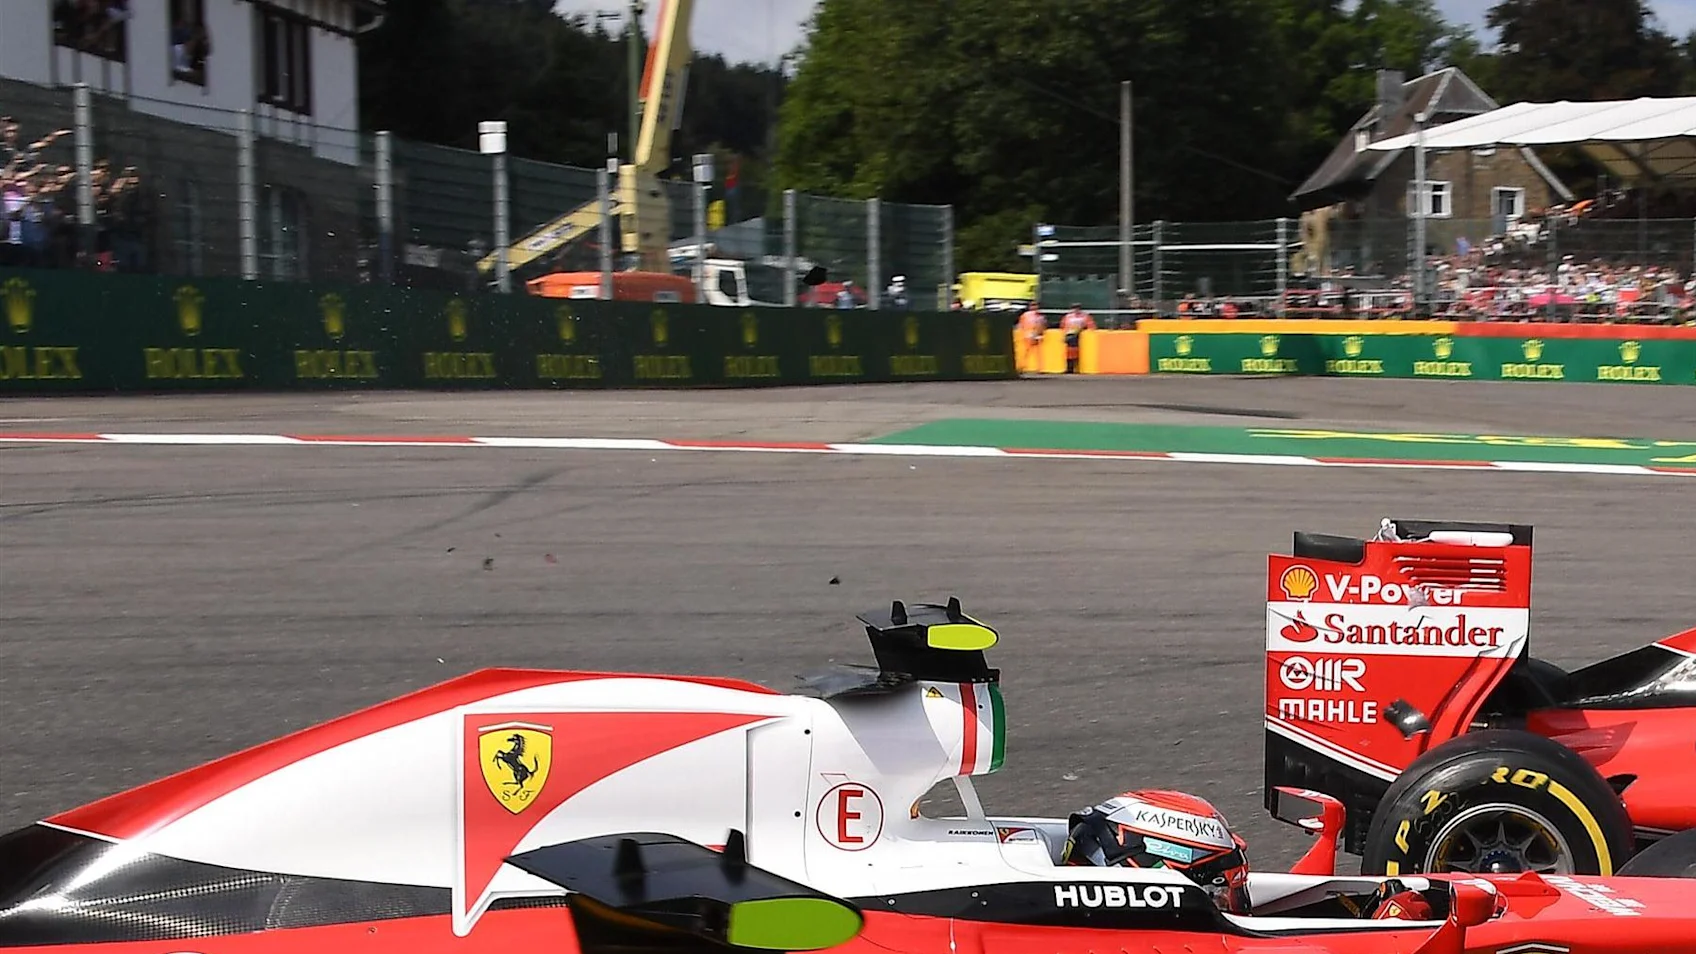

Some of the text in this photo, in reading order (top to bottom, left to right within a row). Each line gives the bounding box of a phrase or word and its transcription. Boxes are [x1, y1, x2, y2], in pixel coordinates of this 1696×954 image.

[0, 346, 82, 379] OLEX
[143, 347, 243, 379] ROLEX
[295, 350, 379, 379] ROLEX
[424, 352, 496, 379] ROLEX
[536, 354, 600, 379] ROLEX
[1157, 357, 1212, 373] ROLEX
[1241, 358, 1297, 374] ROLEX
[1326, 359, 1385, 375] ROLEX
[1413, 361, 1472, 377] ROLEX
[1502, 363, 1565, 379] ROLEX
[1597, 365, 1661, 381] ROLEX
[1324, 614, 1503, 647] Santander
[1279, 699, 1378, 724] MAHLE
[1420, 766, 1550, 816] ZRO
[837, 789, 864, 843] E
[1136, 810, 1215, 838] KASPERSKY
[1054, 885, 1184, 908] HUBLOT
